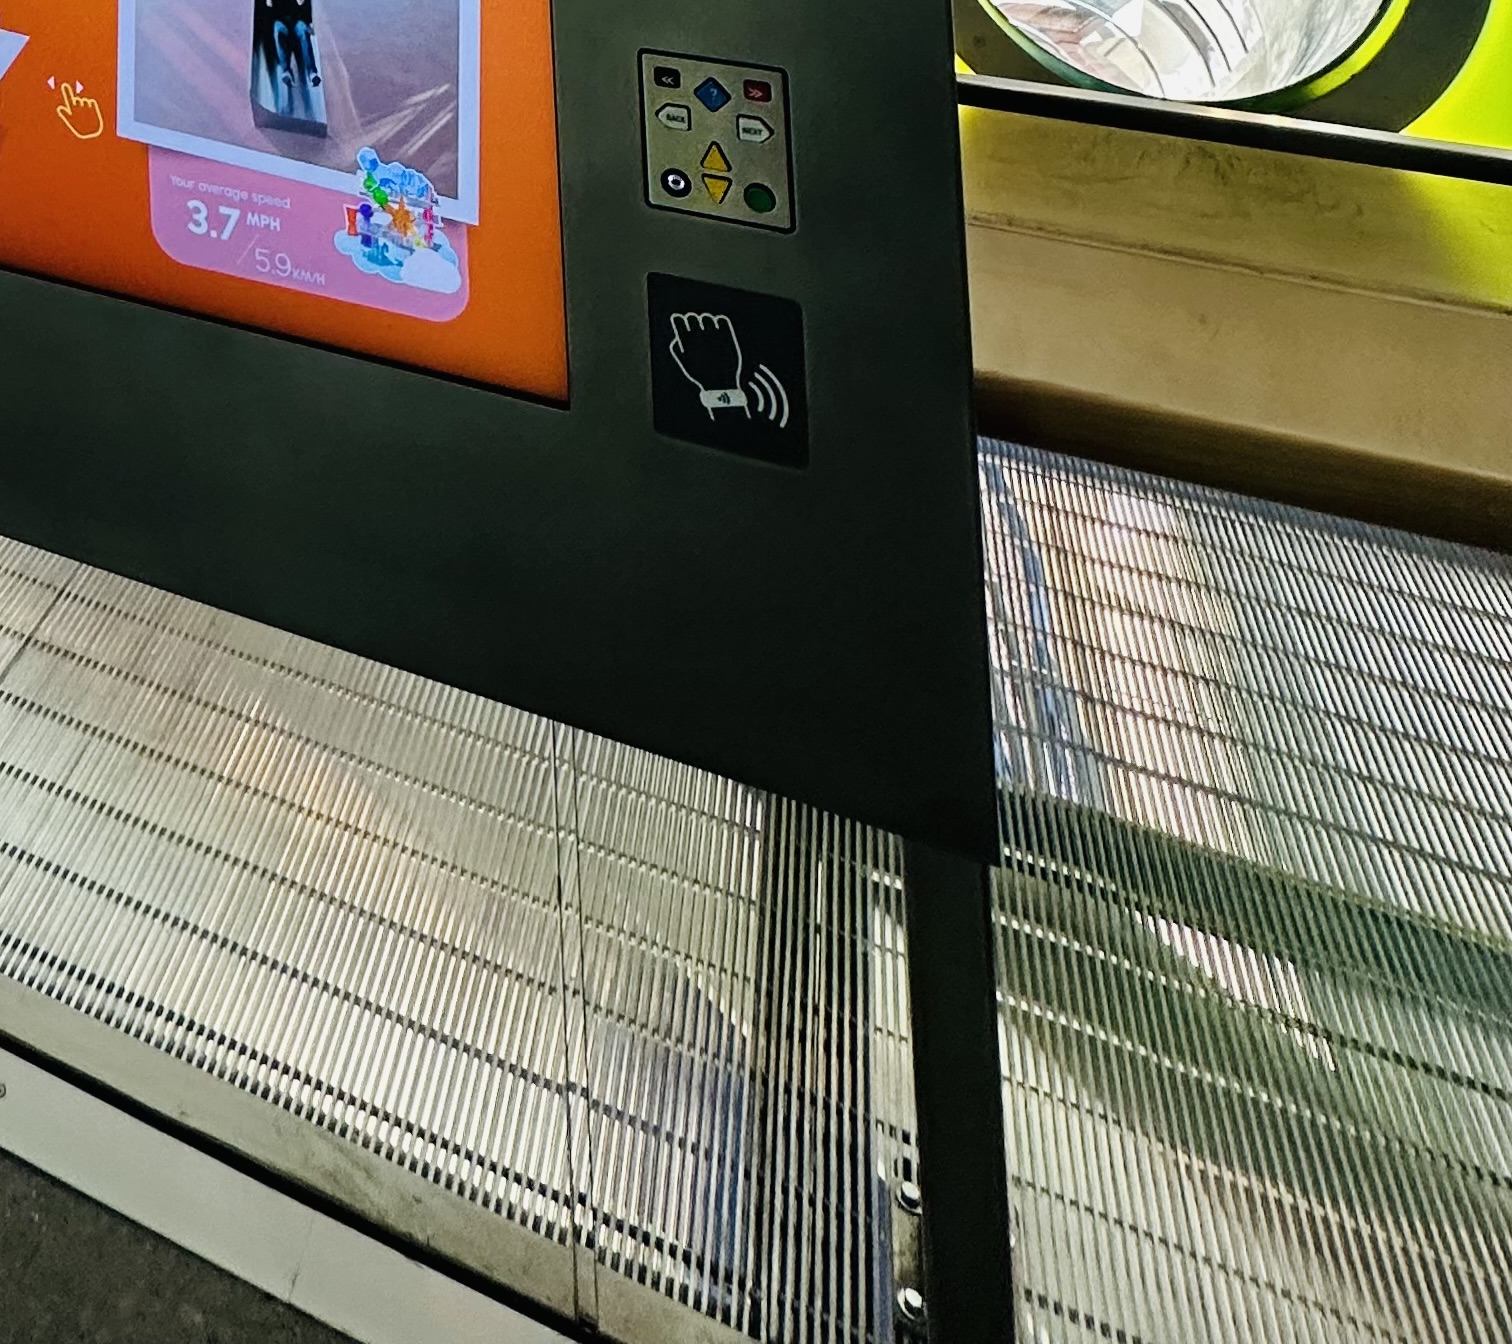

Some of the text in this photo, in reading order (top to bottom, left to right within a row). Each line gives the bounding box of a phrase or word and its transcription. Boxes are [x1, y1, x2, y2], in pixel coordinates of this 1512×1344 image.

[169, 174, 291, 209] Your average speed
[187, 199, 281, 241] 3.7 MPH
